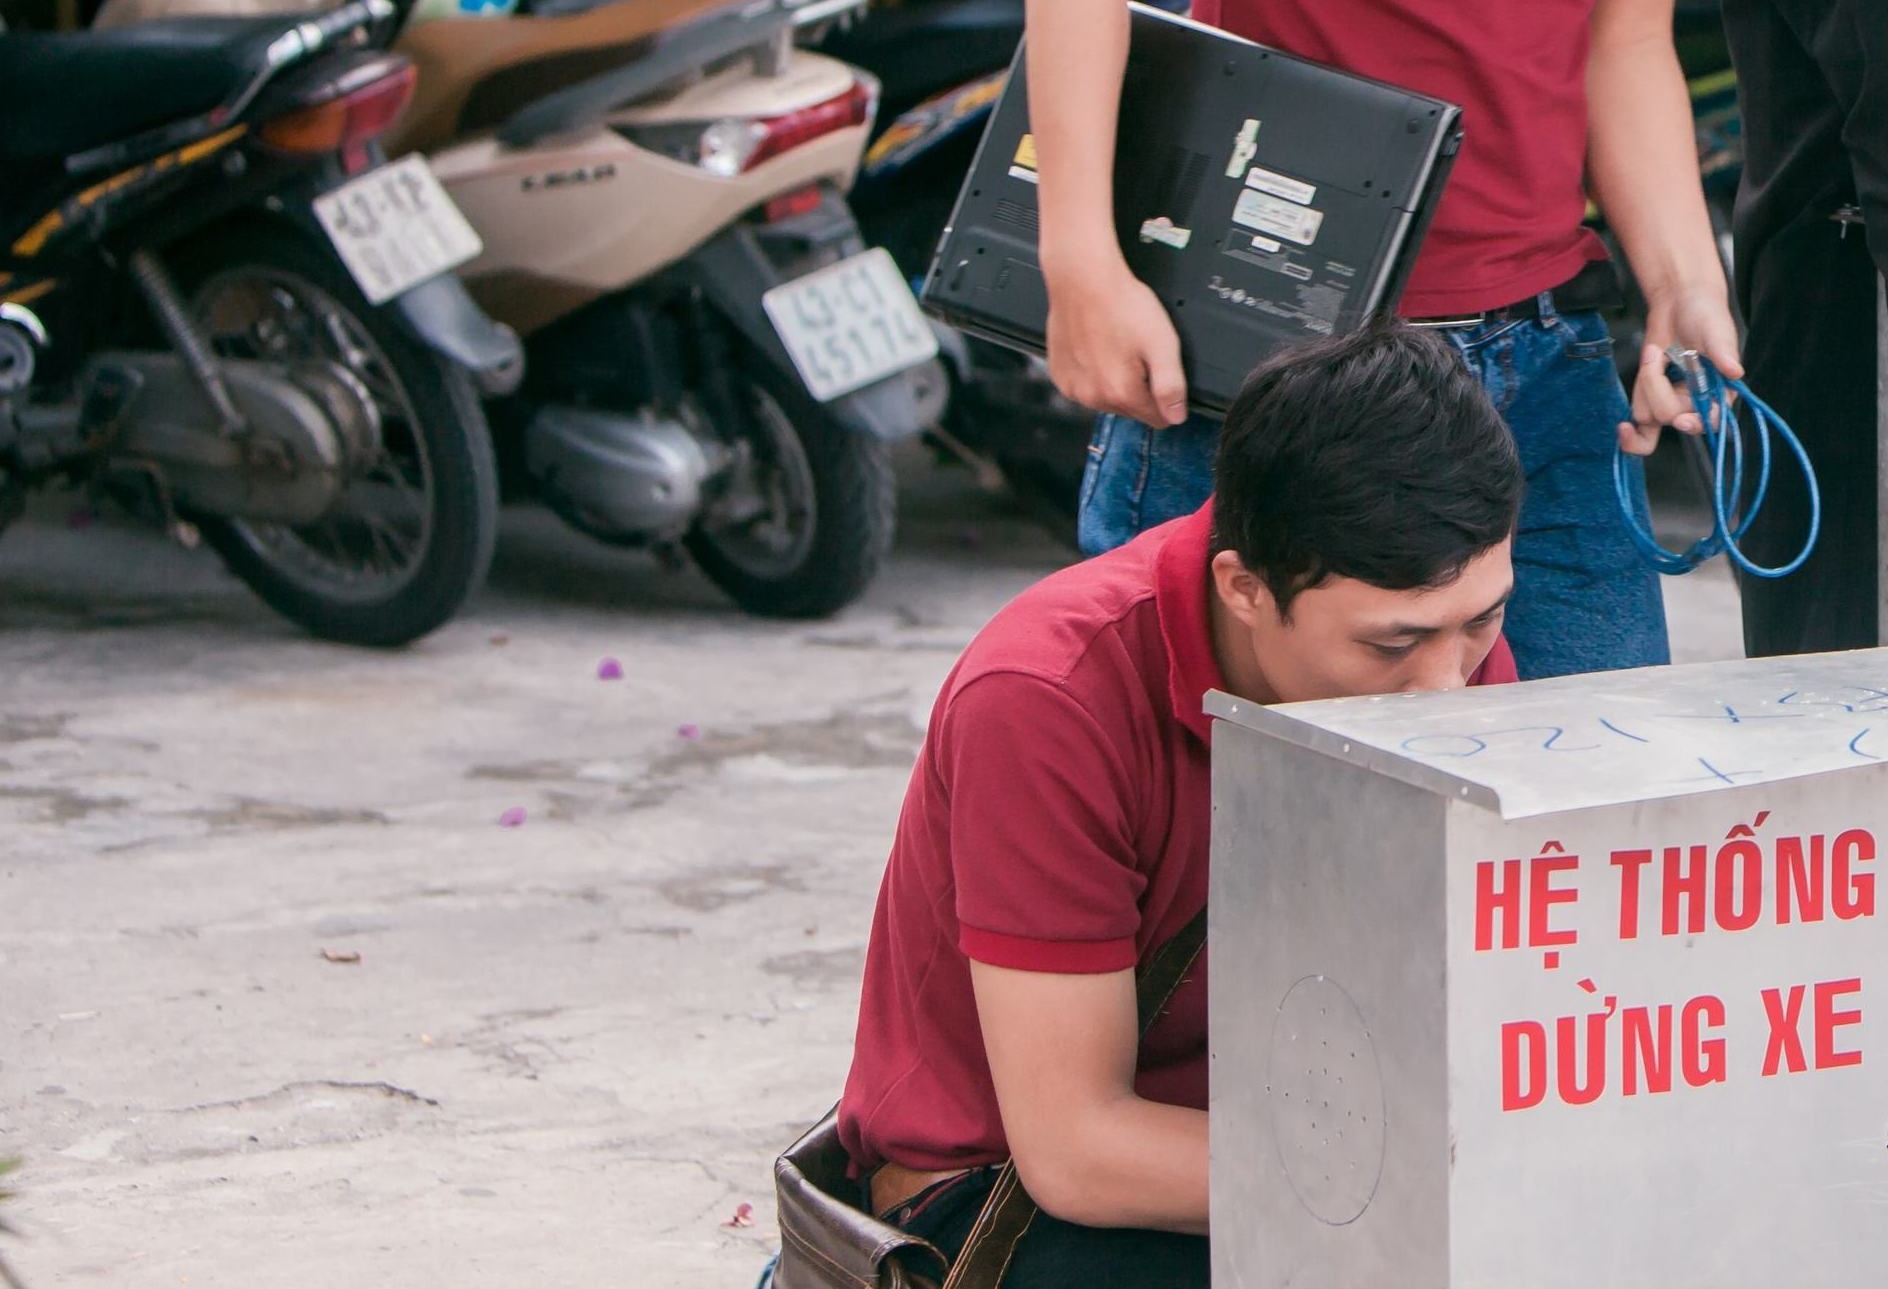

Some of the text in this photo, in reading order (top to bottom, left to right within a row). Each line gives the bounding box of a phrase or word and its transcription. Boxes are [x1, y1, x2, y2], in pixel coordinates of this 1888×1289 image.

[1475, 842, 1579, 970] HỆ
[1610, 813, 1875, 940] THỐNG
[1501, 980, 1726, 1112] DỪNG
[1761, 979, 1862, 1076] XE
